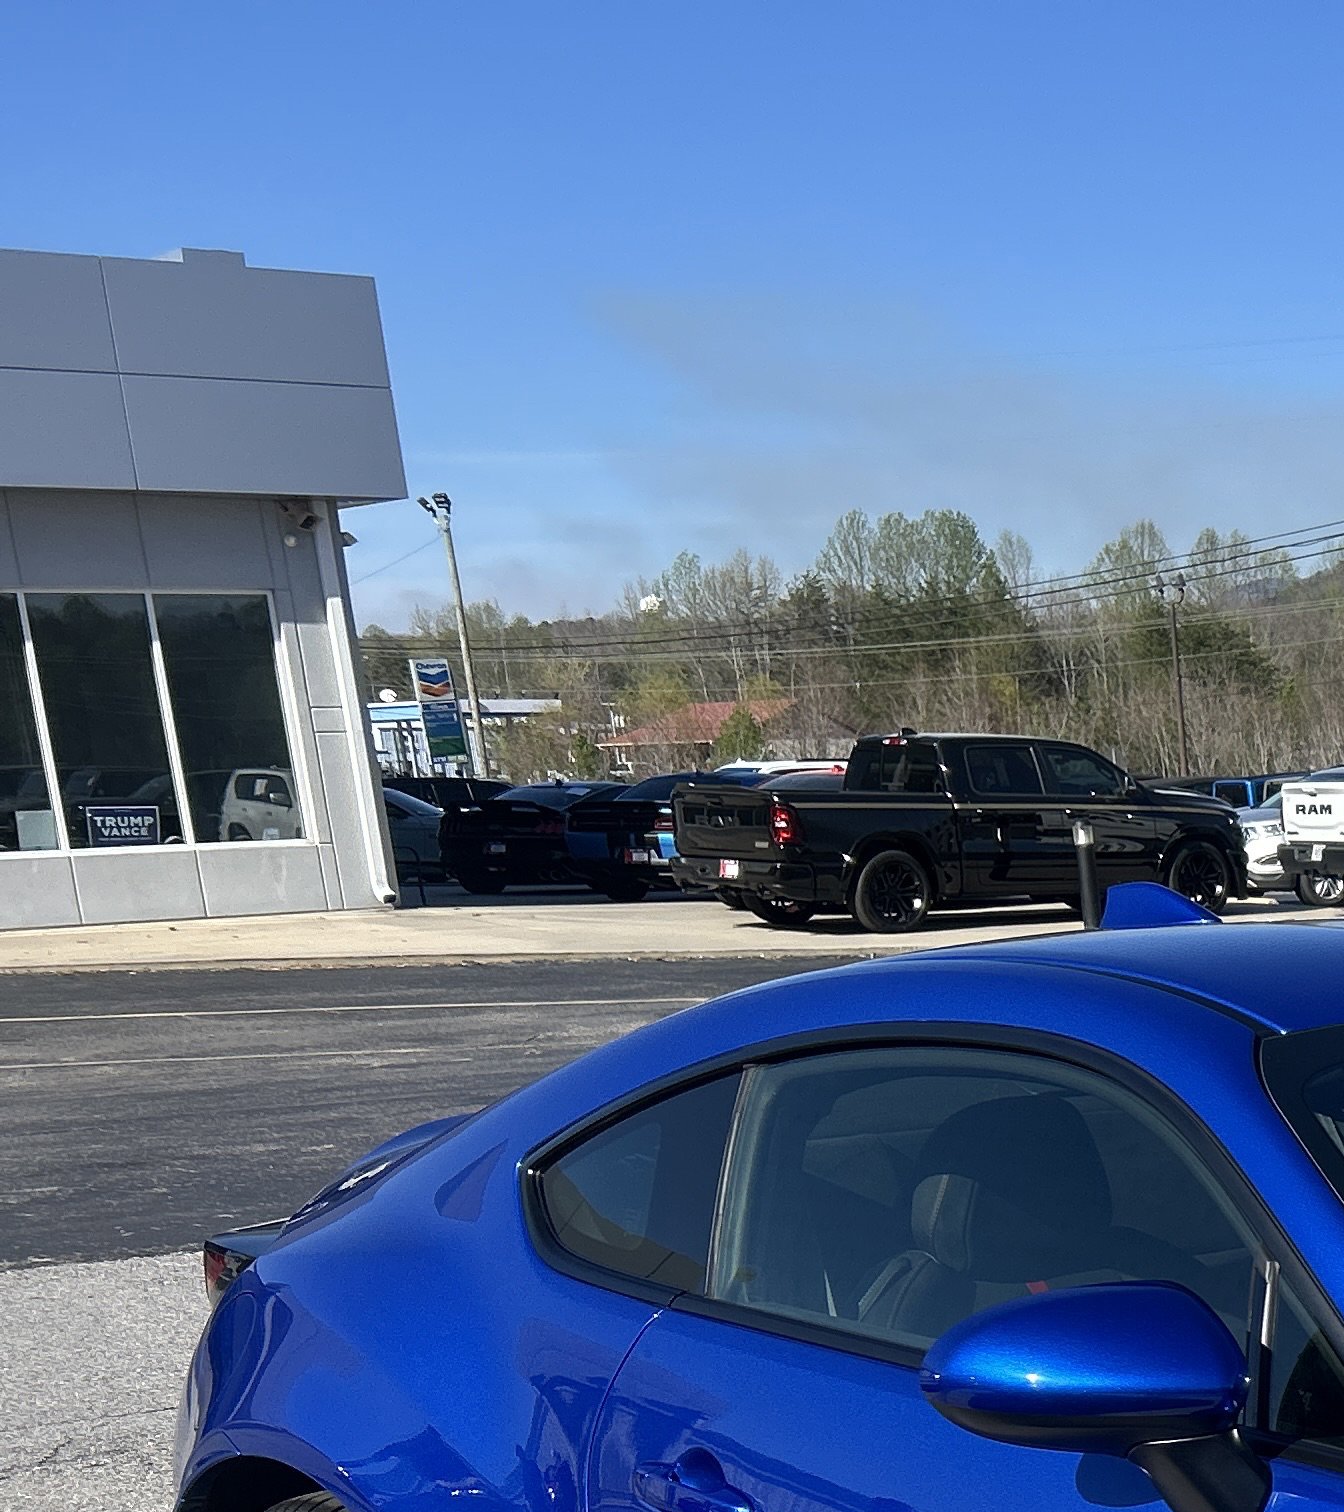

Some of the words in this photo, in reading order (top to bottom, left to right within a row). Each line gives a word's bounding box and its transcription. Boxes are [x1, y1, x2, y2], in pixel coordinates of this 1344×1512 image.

[1295, 804, 1332, 815] RAM
[93, 816, 154, 827] TRUMP
[101, 827, 149, 837] VANCE
